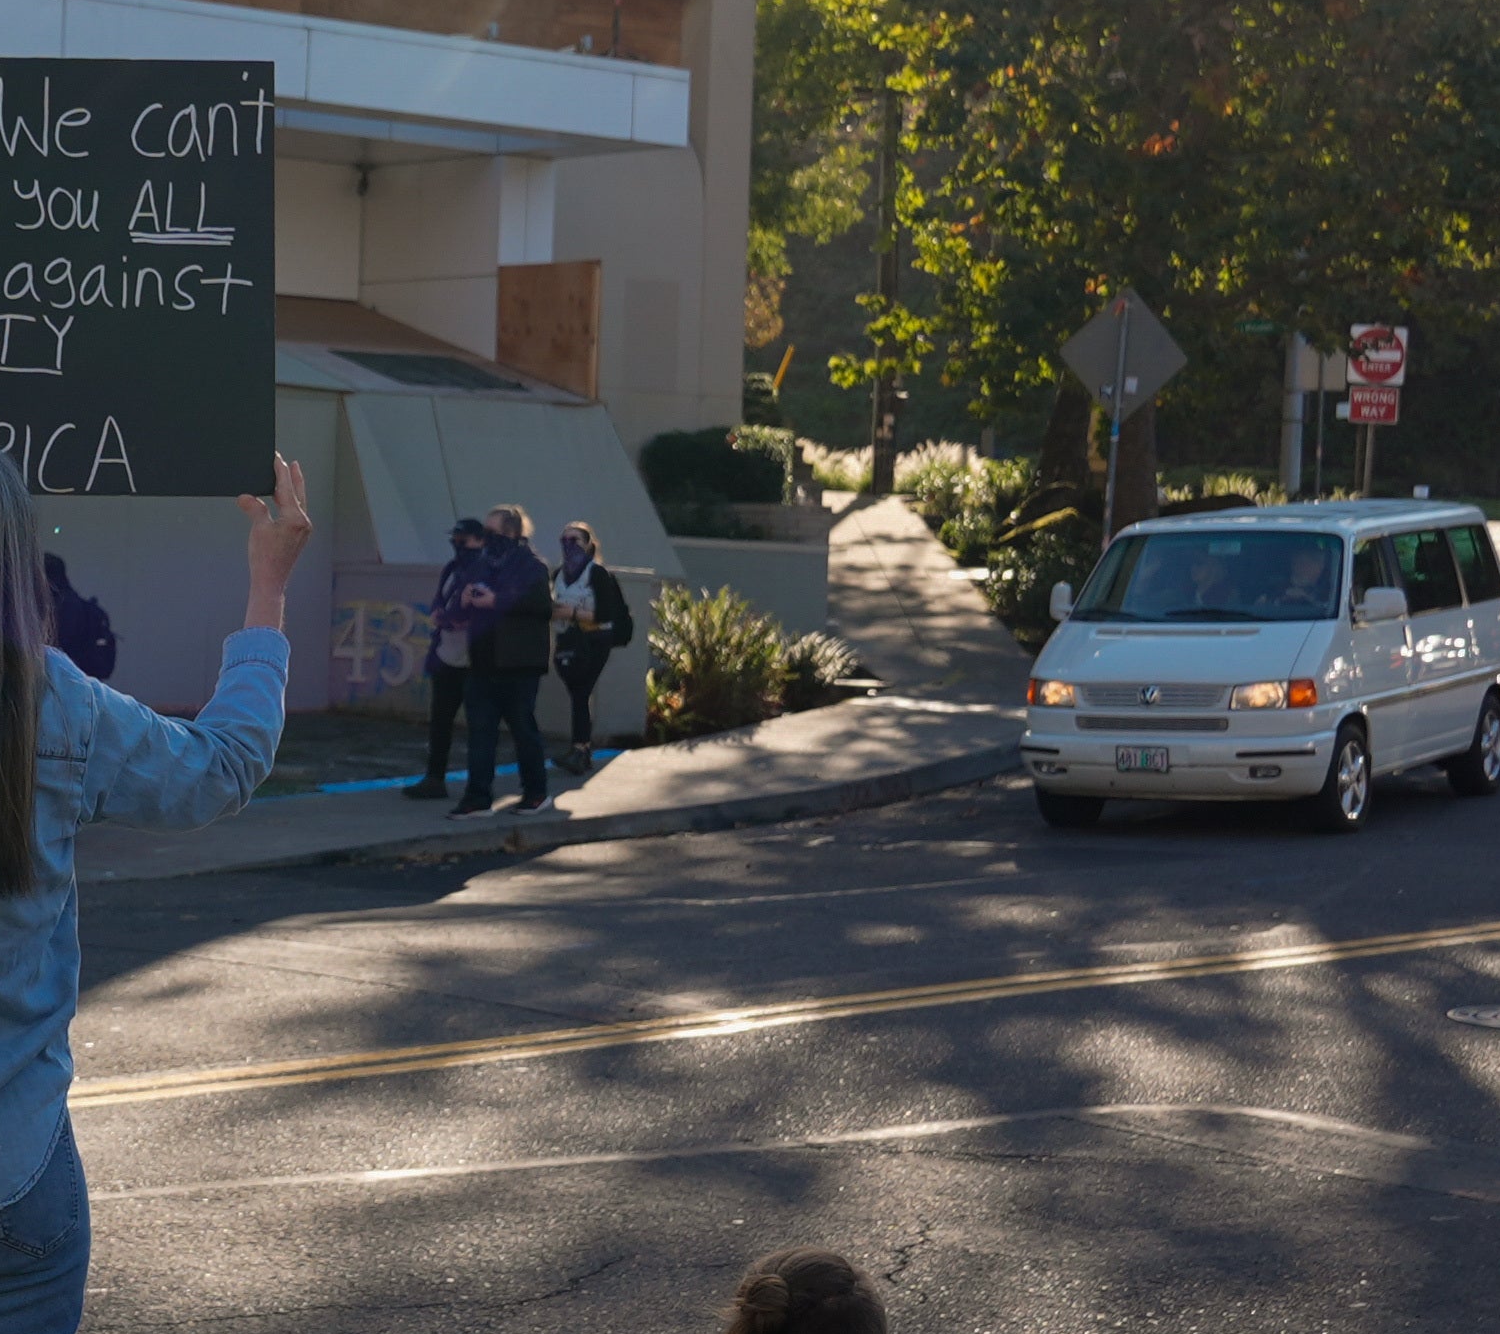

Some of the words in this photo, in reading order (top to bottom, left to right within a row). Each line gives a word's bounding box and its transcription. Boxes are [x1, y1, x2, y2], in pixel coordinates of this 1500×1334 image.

[130, 71, 274, 161] can't
[13, 178, 101, 232] you
[128, 179, 235, 233] ALL
[3, 256, 254, 315] against
[1353, 391, 1395, 406] WRONG
[1361, 405, 1387, 419] WAY
